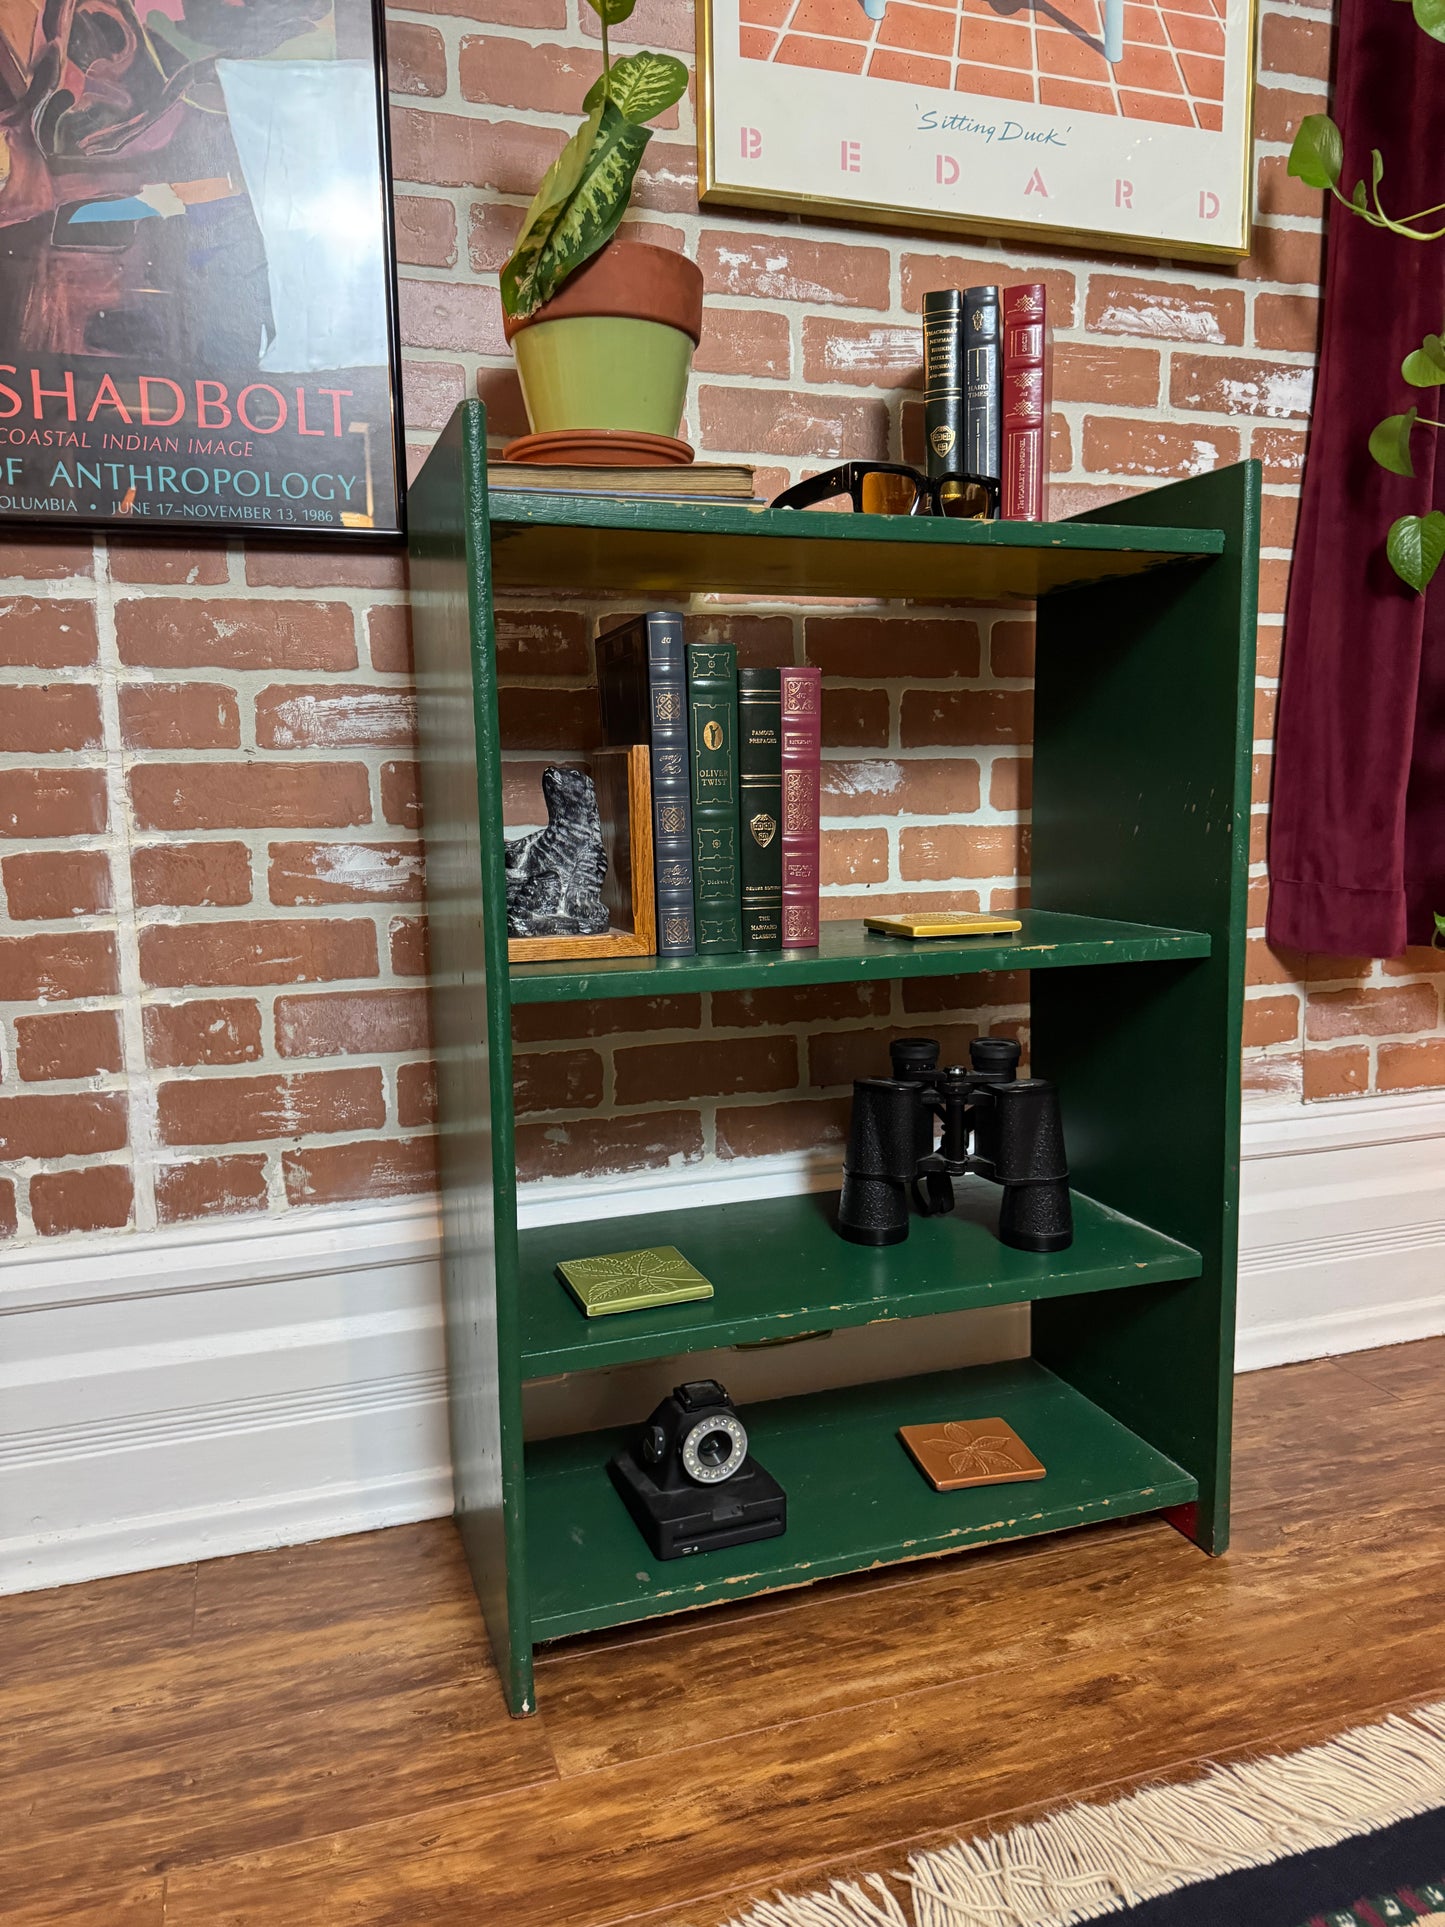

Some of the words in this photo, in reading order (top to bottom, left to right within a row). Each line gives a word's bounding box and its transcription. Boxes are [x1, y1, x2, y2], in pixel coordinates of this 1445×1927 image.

[929, 336, 954, 345] NEWMAN
[968, 384, 989, 392] HARD
[967, 390, 989, 399] TIMES
[0, 364, 354, 438] SHADBOLT
[102, 433, 180, 453] INDIAN
[187, 438, 254, 458] IMAGE
[0, 457, 22, 486] F
[49, 460, 357, 501] ANTHROPOLOGY
[0, 495, 78, 512] OLUMBIA
[111, 500, 151, 516] JUNE
[276, 508, 297, 523] 13,
[302, 508, 334, 522] 1986
[699, 769, 728, 778] OLIVER
[701, 778, 727, 786] TWIST
